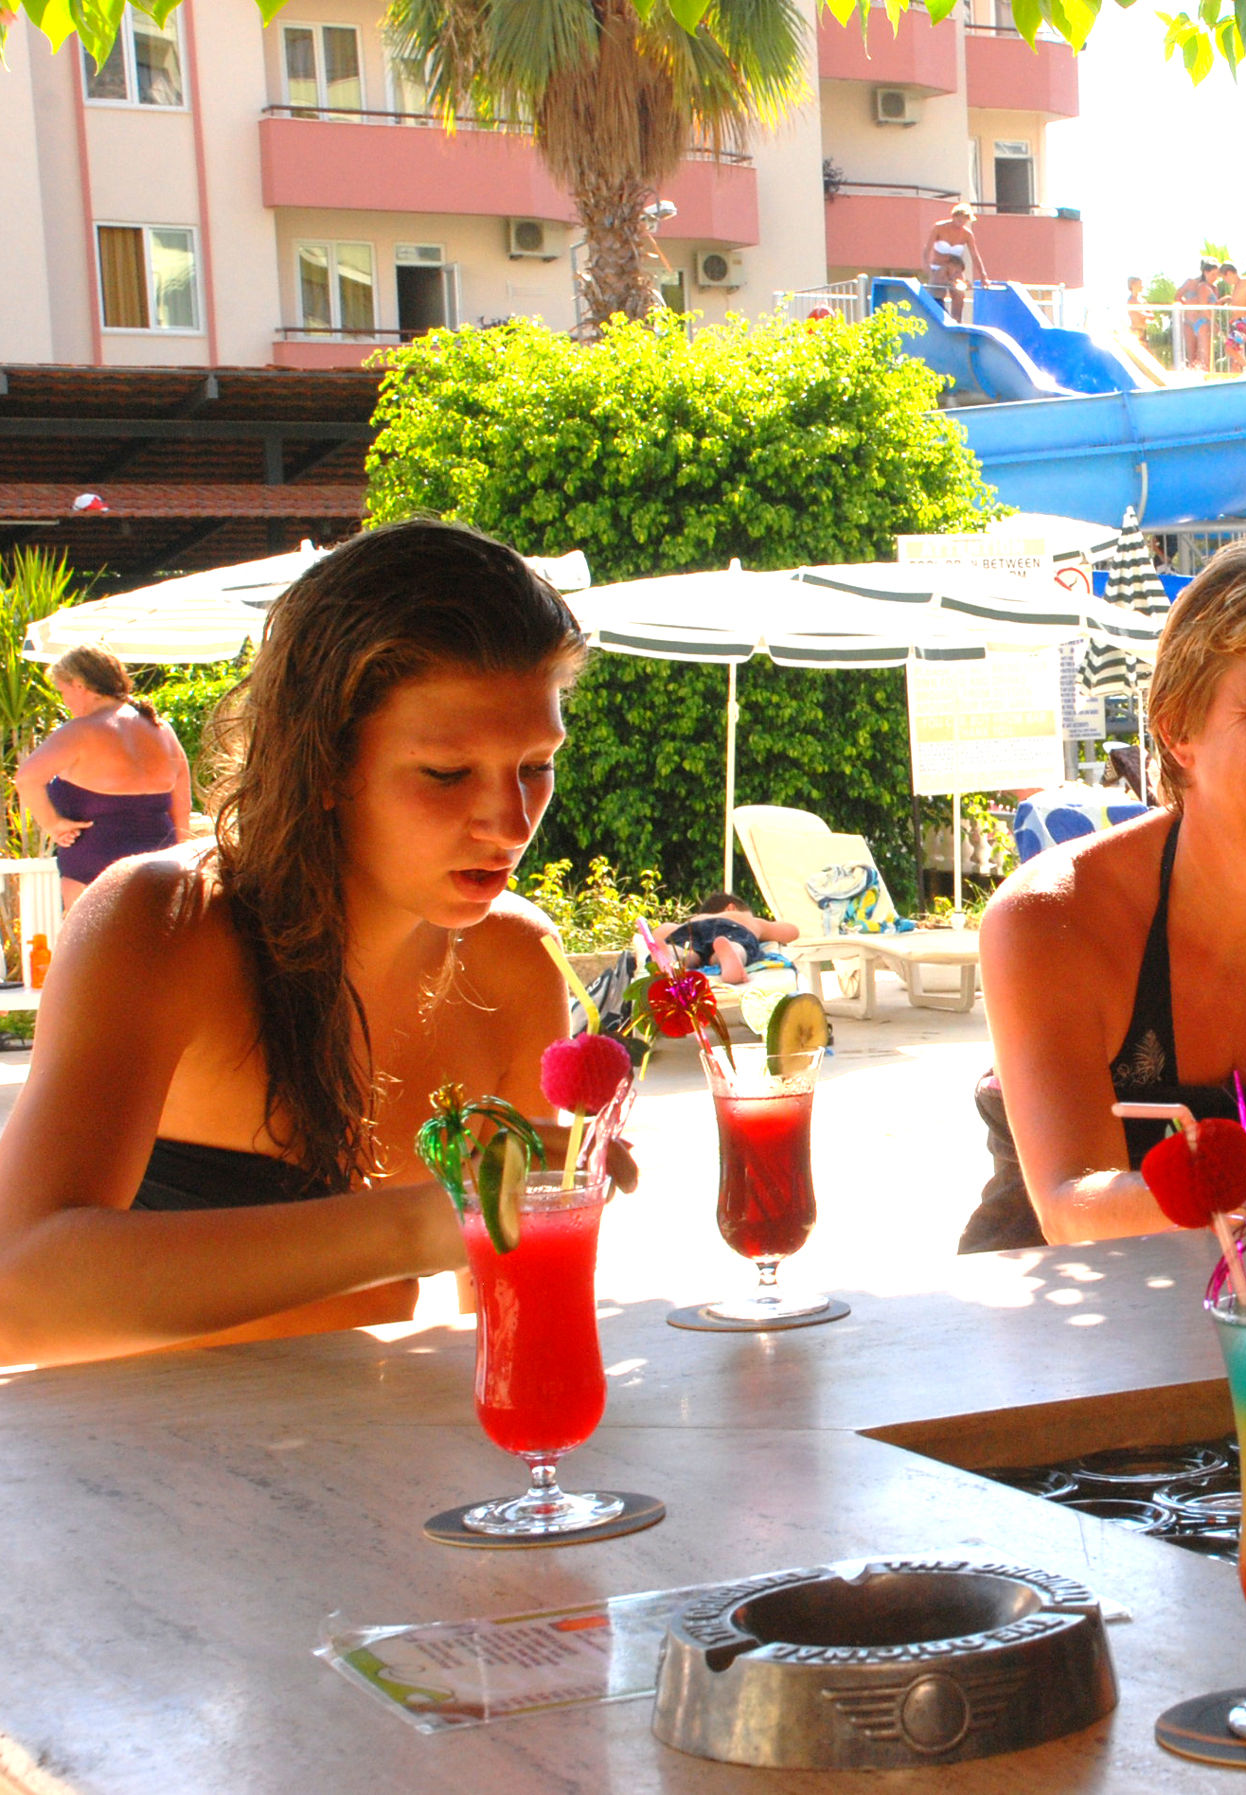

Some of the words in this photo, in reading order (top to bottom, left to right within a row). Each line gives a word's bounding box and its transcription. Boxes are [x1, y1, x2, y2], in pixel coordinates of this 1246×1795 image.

[982, 558, 1041, 569] BETWEEN
[883, 1561, 969, 1572] THE
[972, 1563, 1092, 1604] ORIGINAL
[985, 1618, 1065, 1643] THE
[773, 1635, 986, 1661] ORIGINAL
